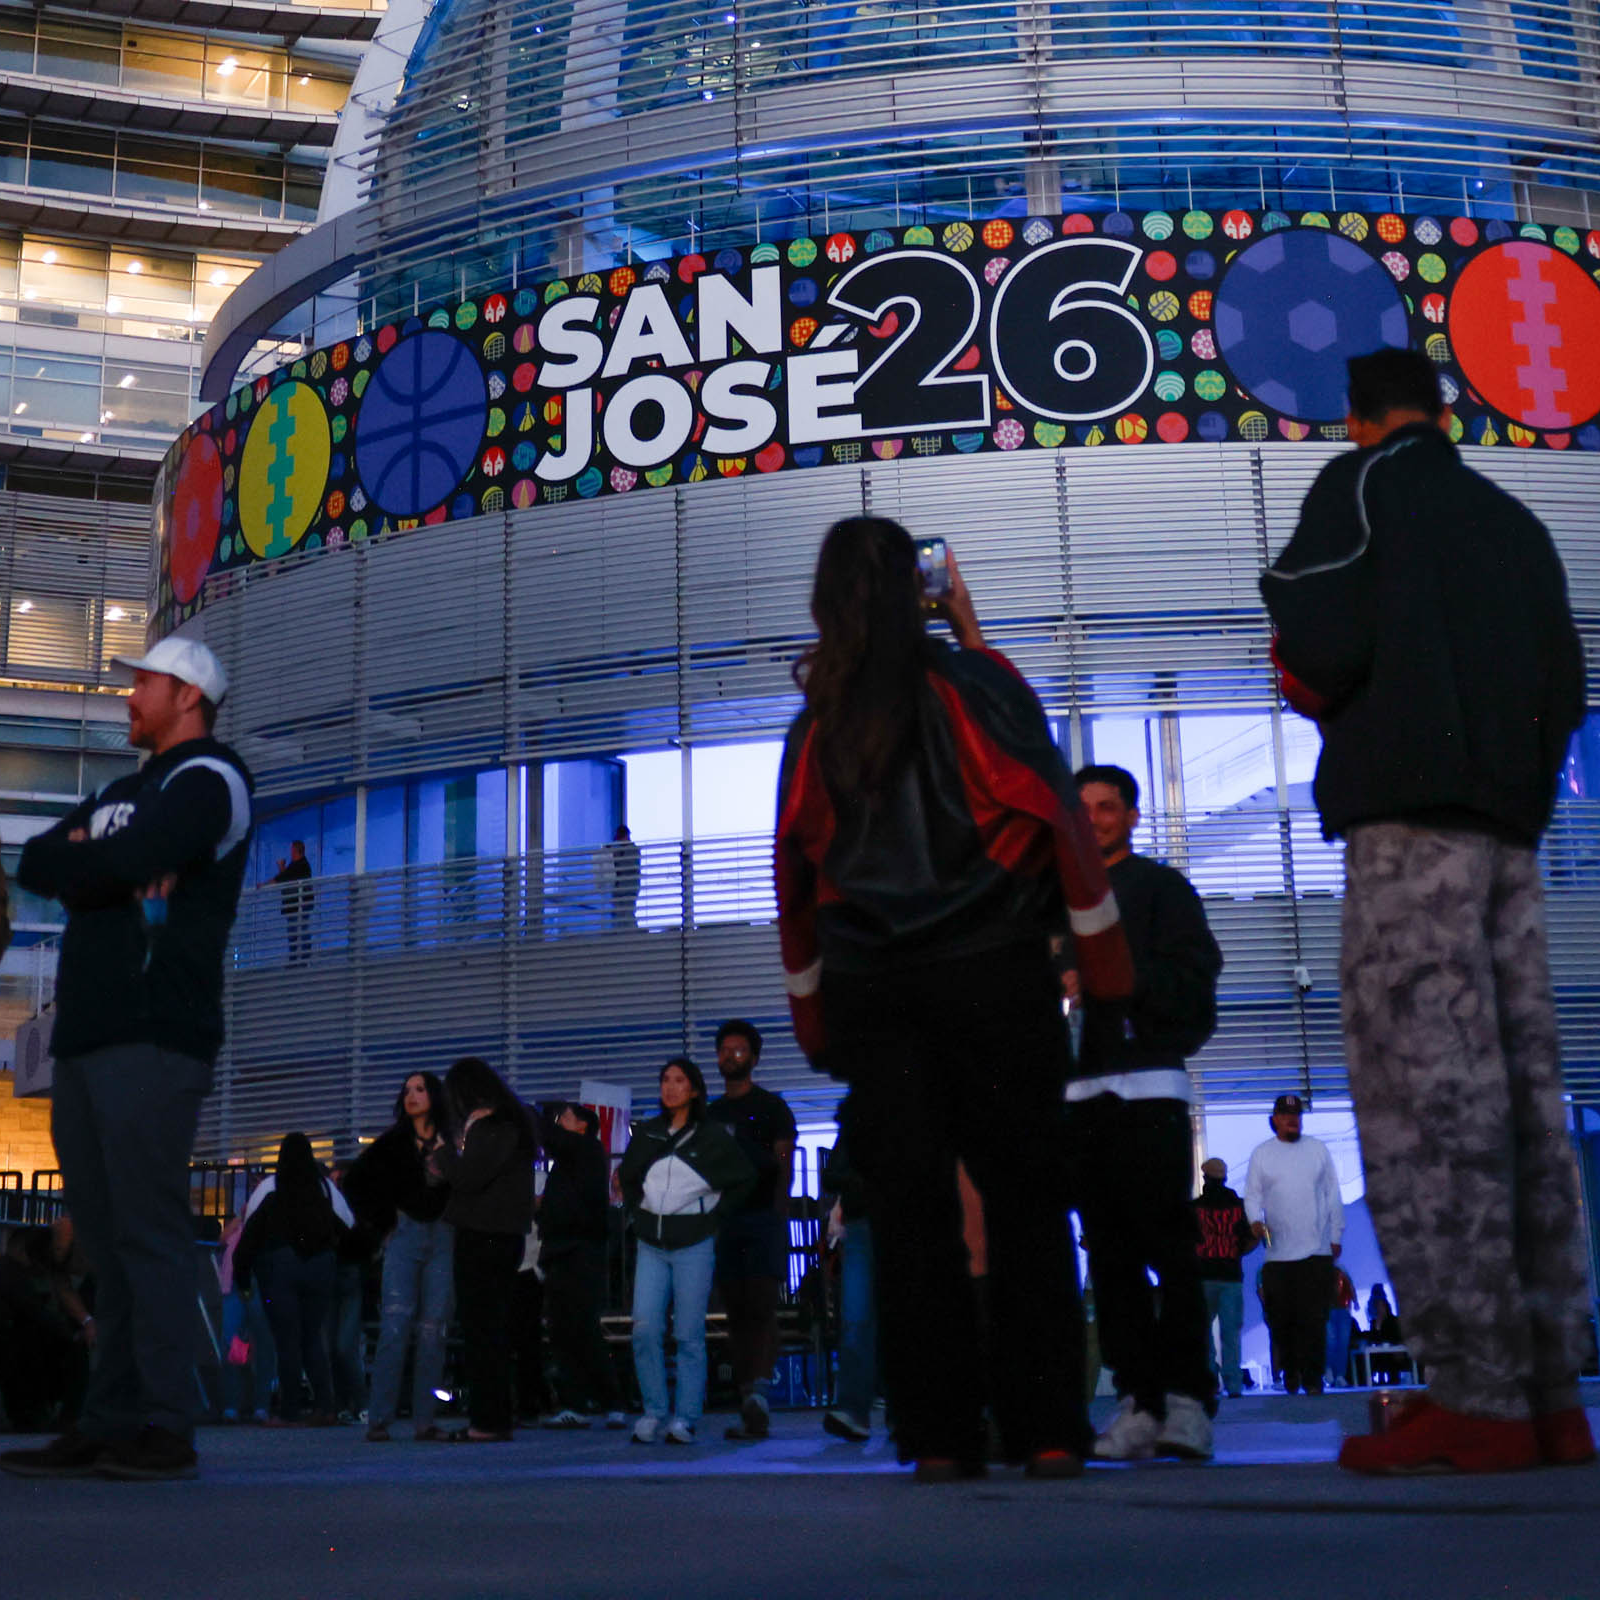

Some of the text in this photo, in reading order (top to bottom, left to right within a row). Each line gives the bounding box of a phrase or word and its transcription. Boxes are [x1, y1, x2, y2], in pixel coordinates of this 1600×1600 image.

[534, 238, 1155, 481] JOSÉ 26
[537, 265, 783, 388] SAN
